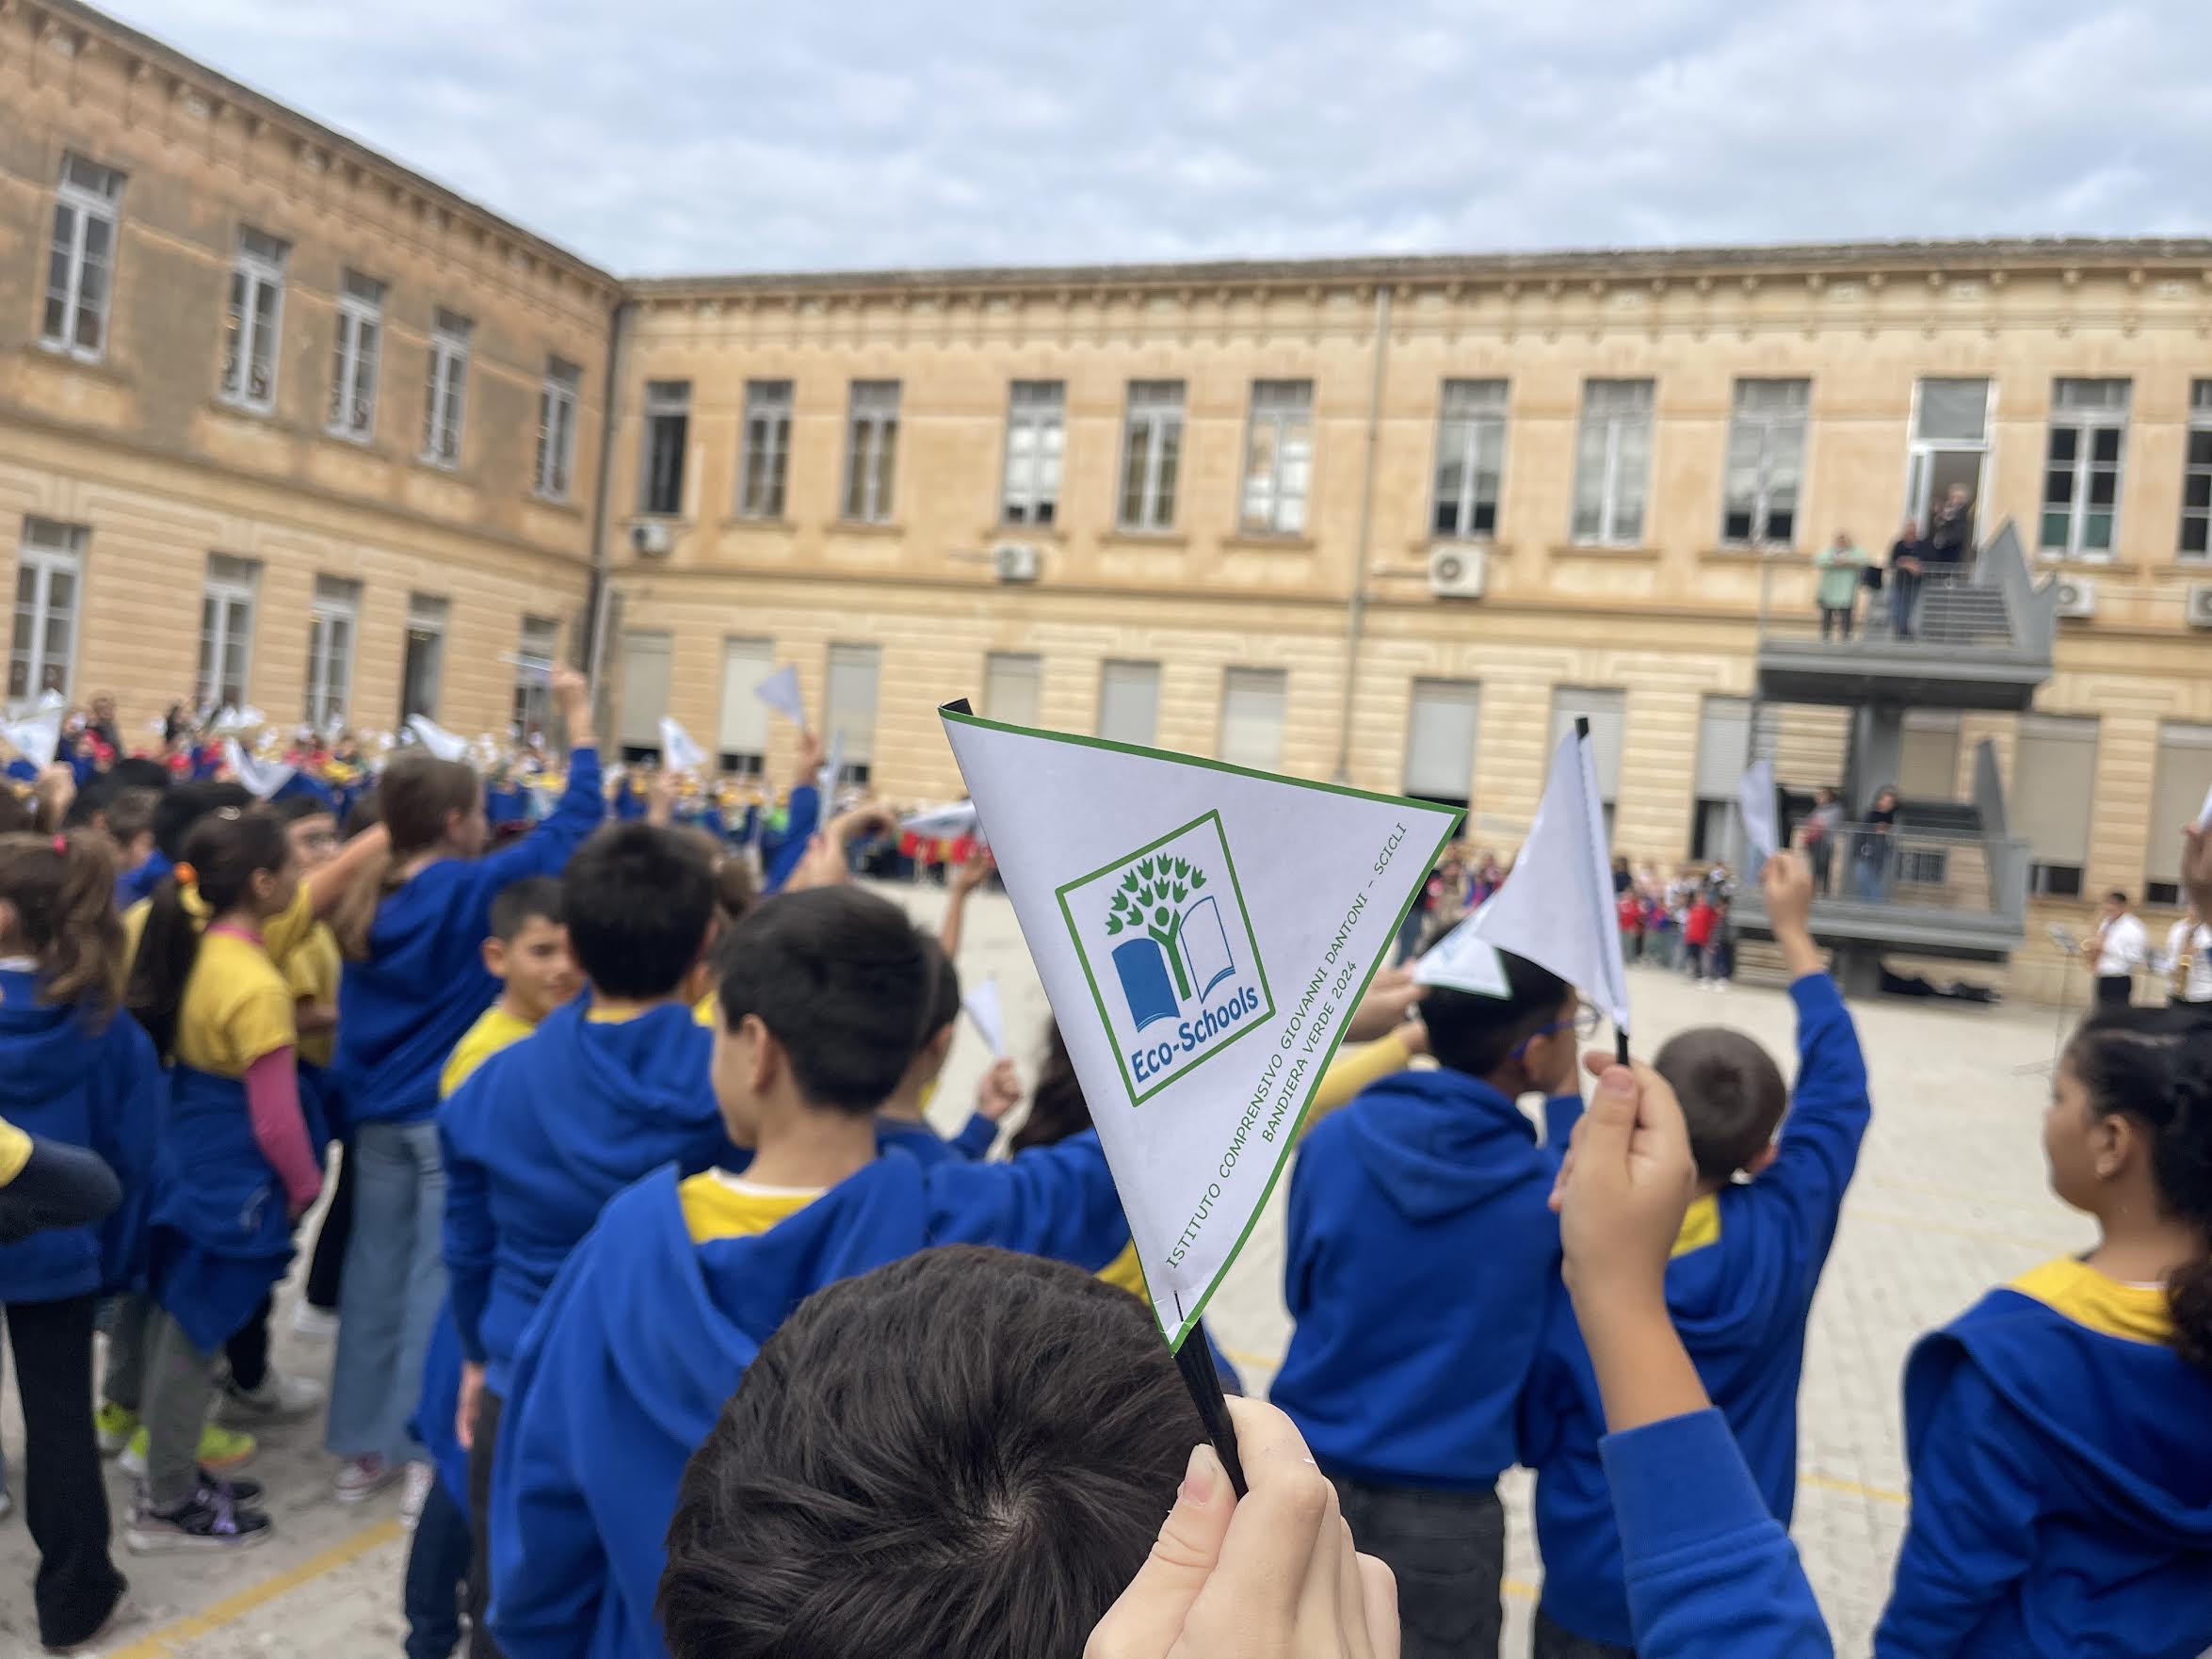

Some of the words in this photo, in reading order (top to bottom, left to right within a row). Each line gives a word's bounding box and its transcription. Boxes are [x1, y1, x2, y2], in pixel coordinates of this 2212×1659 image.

[1131, 986, 1259, 1084] Eco-Schools
[1166, 1183, 1220, 1268] ISTITUTO
[1219, 1054, 1284, 1179] COMPRENSIVO
[1281, 967, 1328, 1051] GIOVANNI
[1325, 892, 1369, 964] DANTONI
[1373, 821, 1408, 876] SCICLI
[1262, 1057, 1308, 1143] BANDIERA
[1303, 1001, 1335, 1055] VERDE
[1332, 960, 1357, 1000] 2024
